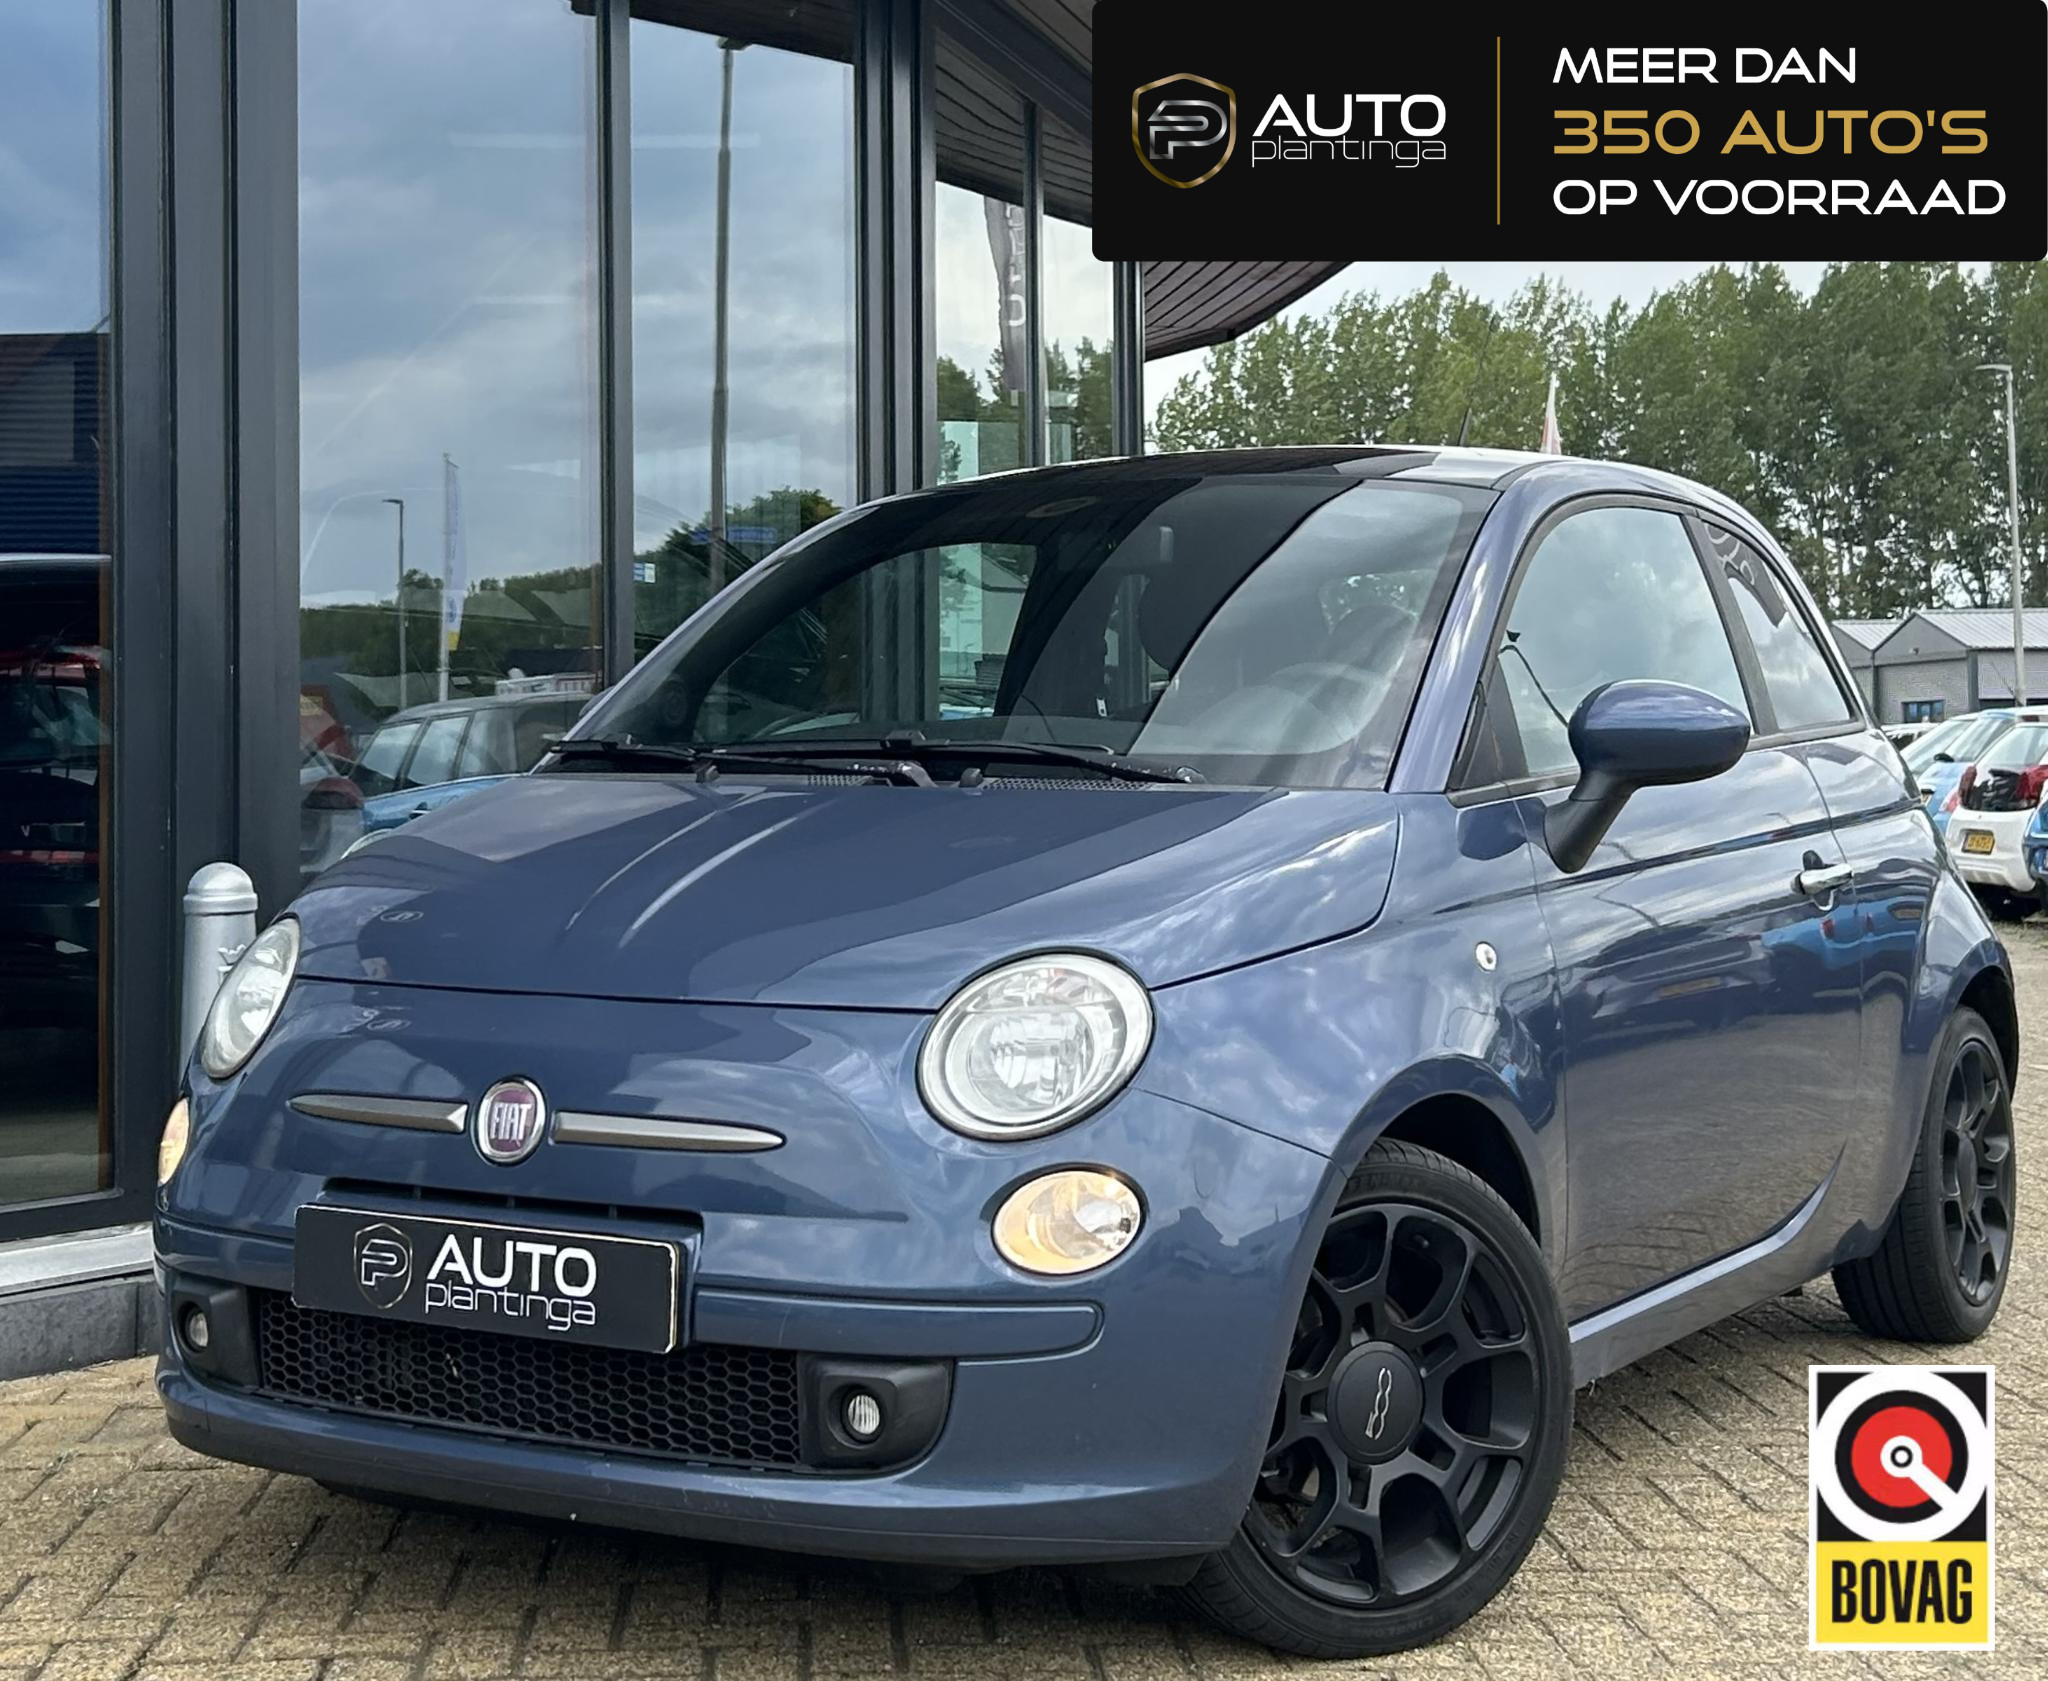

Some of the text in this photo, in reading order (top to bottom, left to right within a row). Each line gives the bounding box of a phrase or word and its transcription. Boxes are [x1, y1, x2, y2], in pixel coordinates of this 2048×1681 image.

[489, 1102, 532, 1141] FIAT
[427, 1233, 598, 1298] AUTO
[424, 1280, 597, 1331] plantinga
